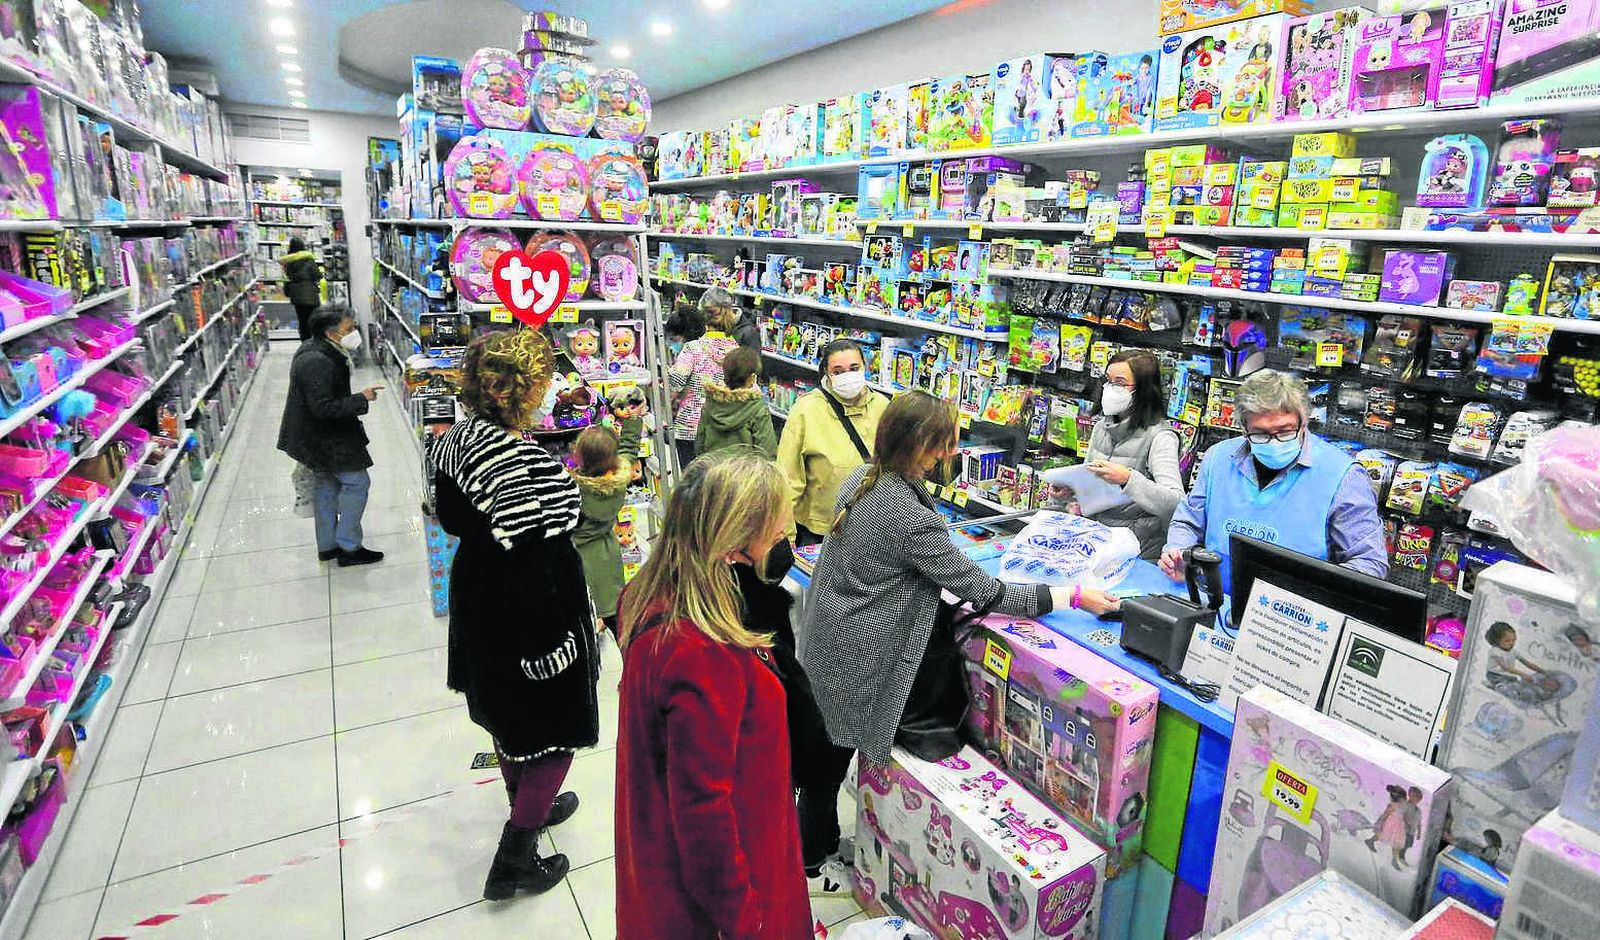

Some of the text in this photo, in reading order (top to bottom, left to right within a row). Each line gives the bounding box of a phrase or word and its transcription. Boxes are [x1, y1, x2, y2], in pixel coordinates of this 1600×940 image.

[1507, 4, 1567, 27] AMAZING
[1512, 17, 1560, 34] SURPRISE
[500, 256, 560, 315] ty
[1273, 602, 1312, 625] CARRION
[1277, 772, 1307, 795] OFERTA
[1276, 789, 1300, 809] 19.99
